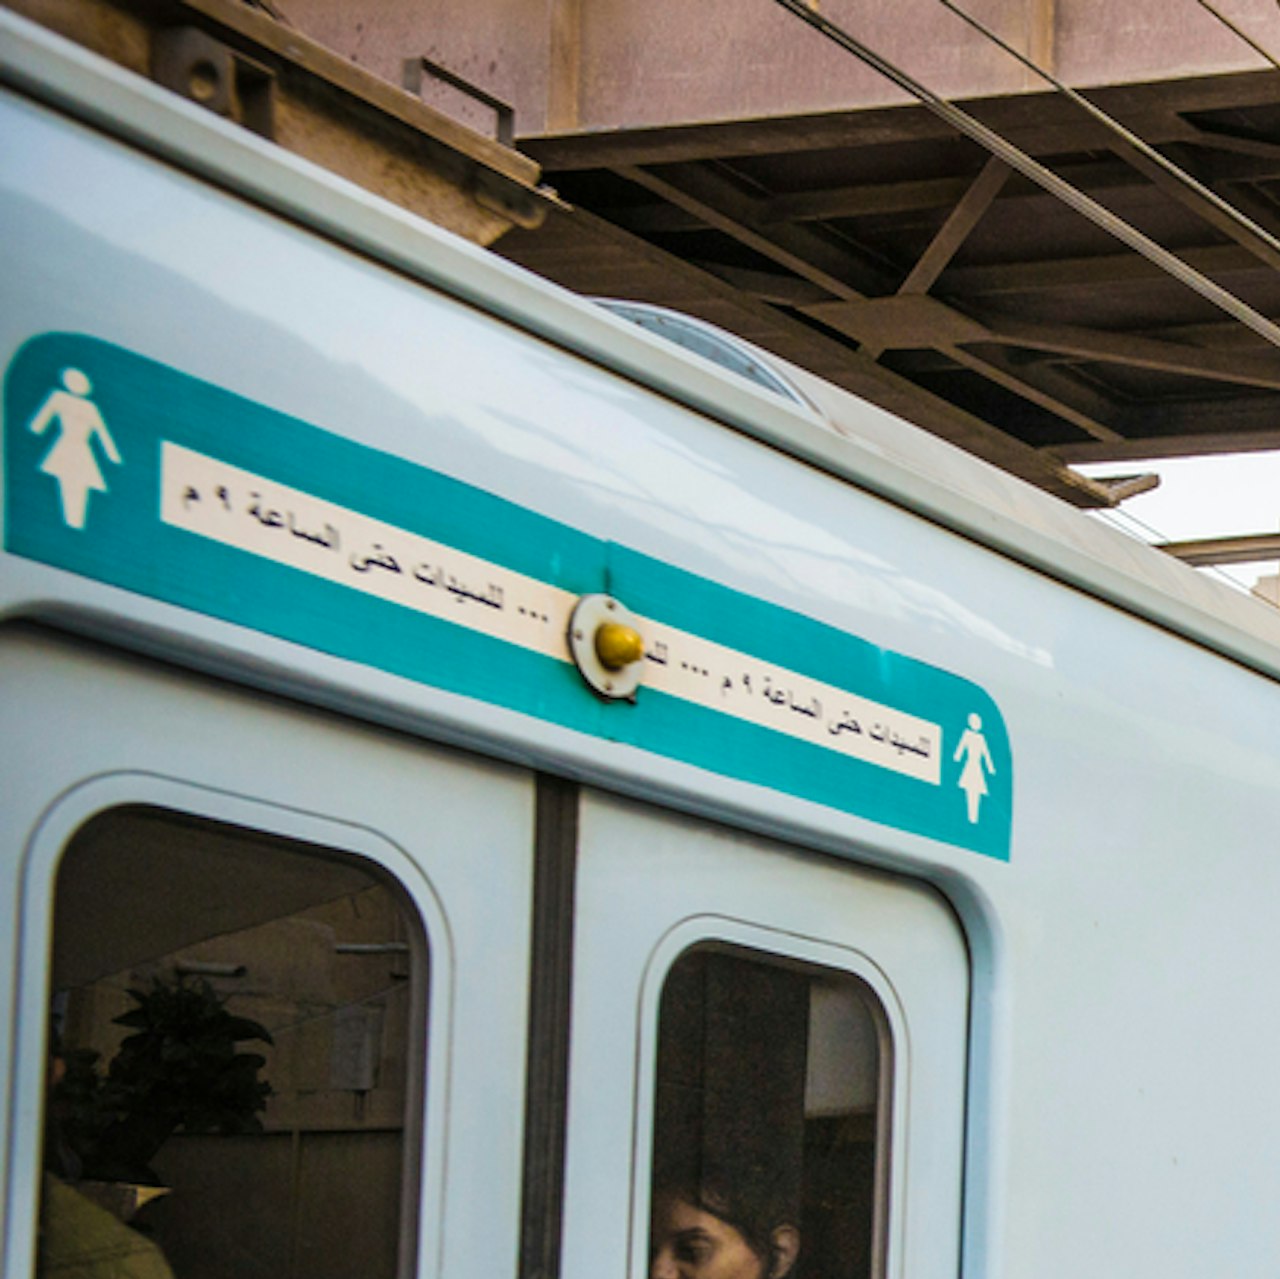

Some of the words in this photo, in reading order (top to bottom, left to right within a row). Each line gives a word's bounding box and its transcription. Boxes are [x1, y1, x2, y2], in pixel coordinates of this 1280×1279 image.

[247, 489, 341, 554] الساعة
[350, 542, 404, 574] حتى
[412, 562, 505, 610] للسيدات
[762, 675, 823, 720] الساعة
[828, 710, 864, 736] حتى
